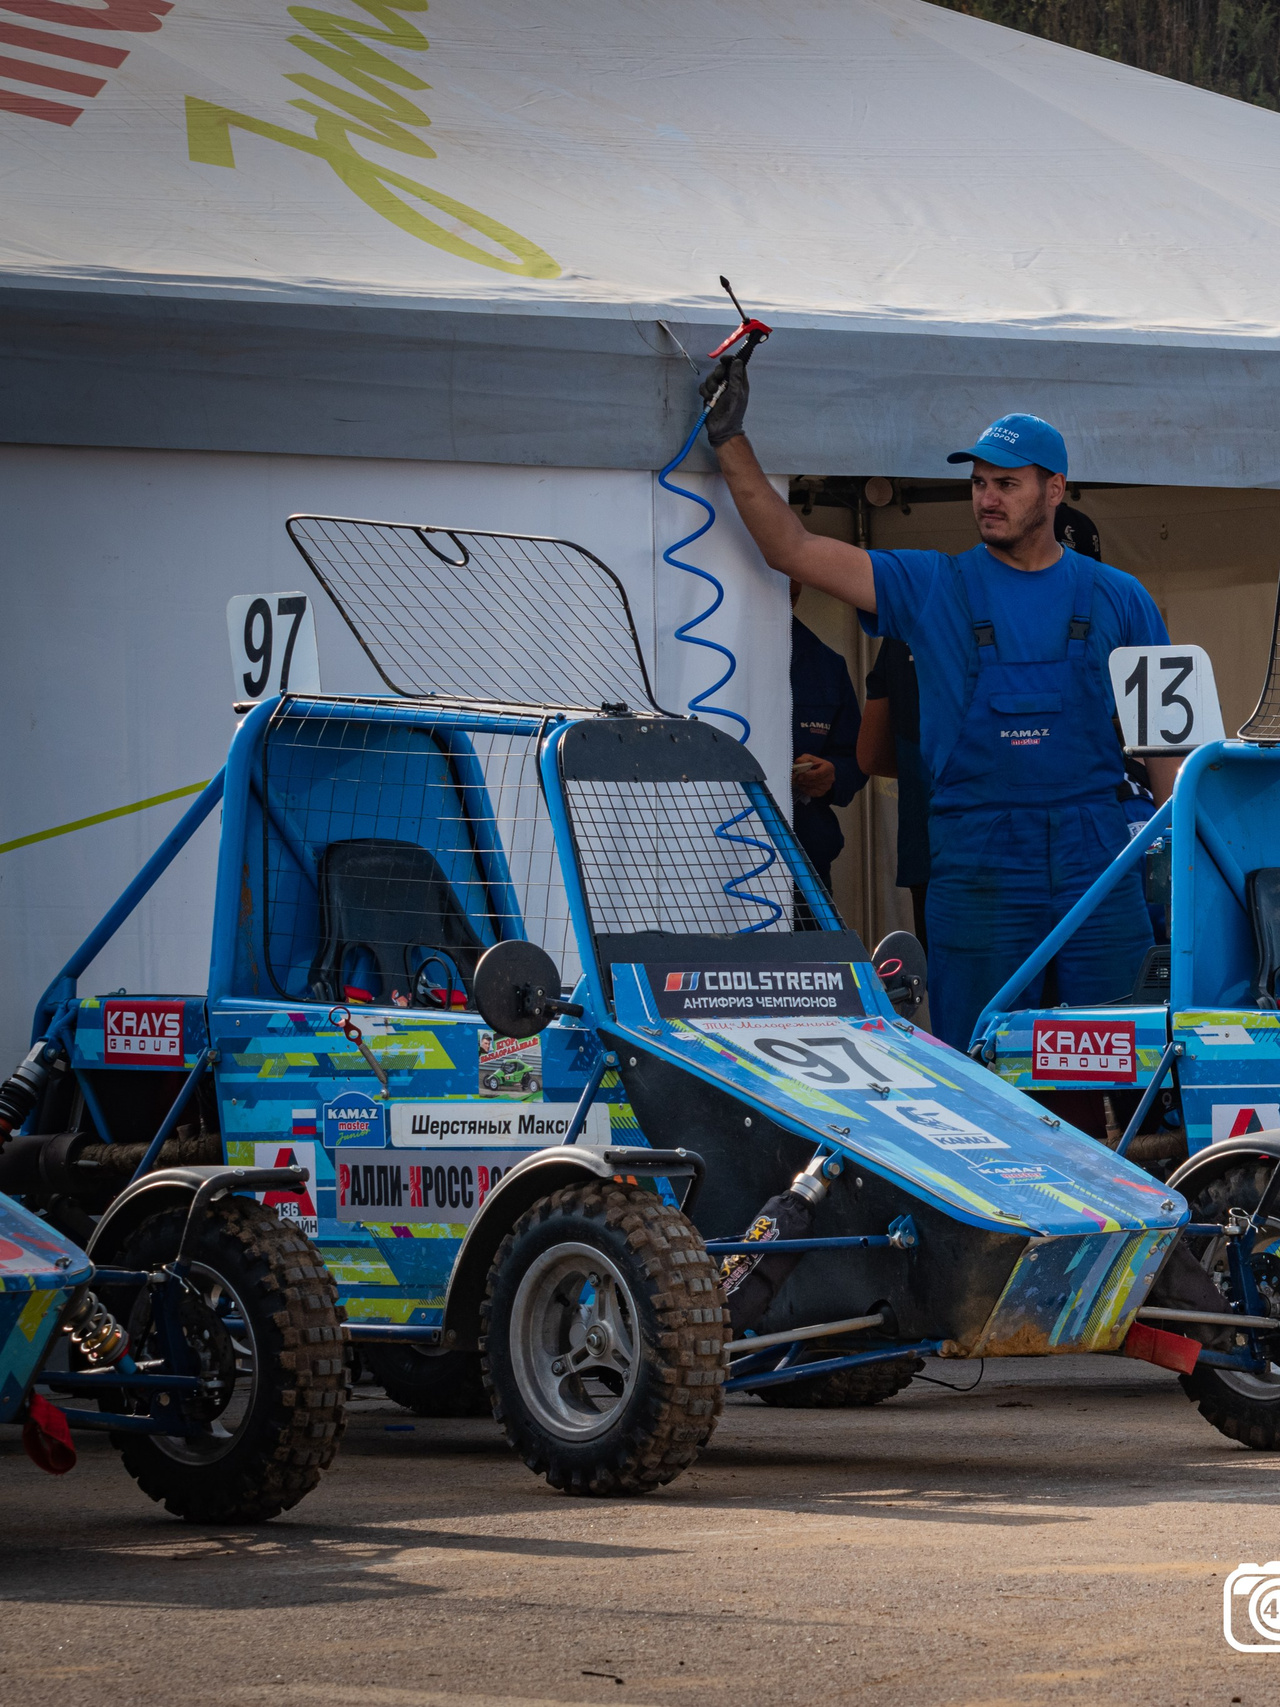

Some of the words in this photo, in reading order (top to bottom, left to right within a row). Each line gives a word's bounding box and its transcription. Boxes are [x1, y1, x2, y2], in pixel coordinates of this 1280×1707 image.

[994, 427, 1020, 438] ТЕХНО
[243, 596, 307, 697] 97
[1125, 656, 1194, 746] 13
[1000, 728, 1050, 738] KAMAZ
[704, 972, 844, 990] COOLSTREAM
[684, 997, 754, 1009] АНТИФРИЗ
[756, 997, 837, 1008] ЧЕМПИОНОВ
[107, 1010, 180, 1036] KRAYS
[110, 1038, 177, 1052] GROUP
[1036, 1030, 1131, 1055] KRAYS
[754, 1037, 893, 1084] 97
[1040, 1056, 1128, 1069] GROUP
[328, 1108, 378, 1119] KAMAZ
[338, 1120, 369, 1131] master
[411, 1114, 511, 1140] Шерстяных
[336, 1129, 371, 1146] Junior
[933, 1136, 997, 1145] KAMAZ
[978, 1166, 1048, 1176] KAMAZ
[339, 1163, 474, 1208] РАЛЛИ-КРОСС
